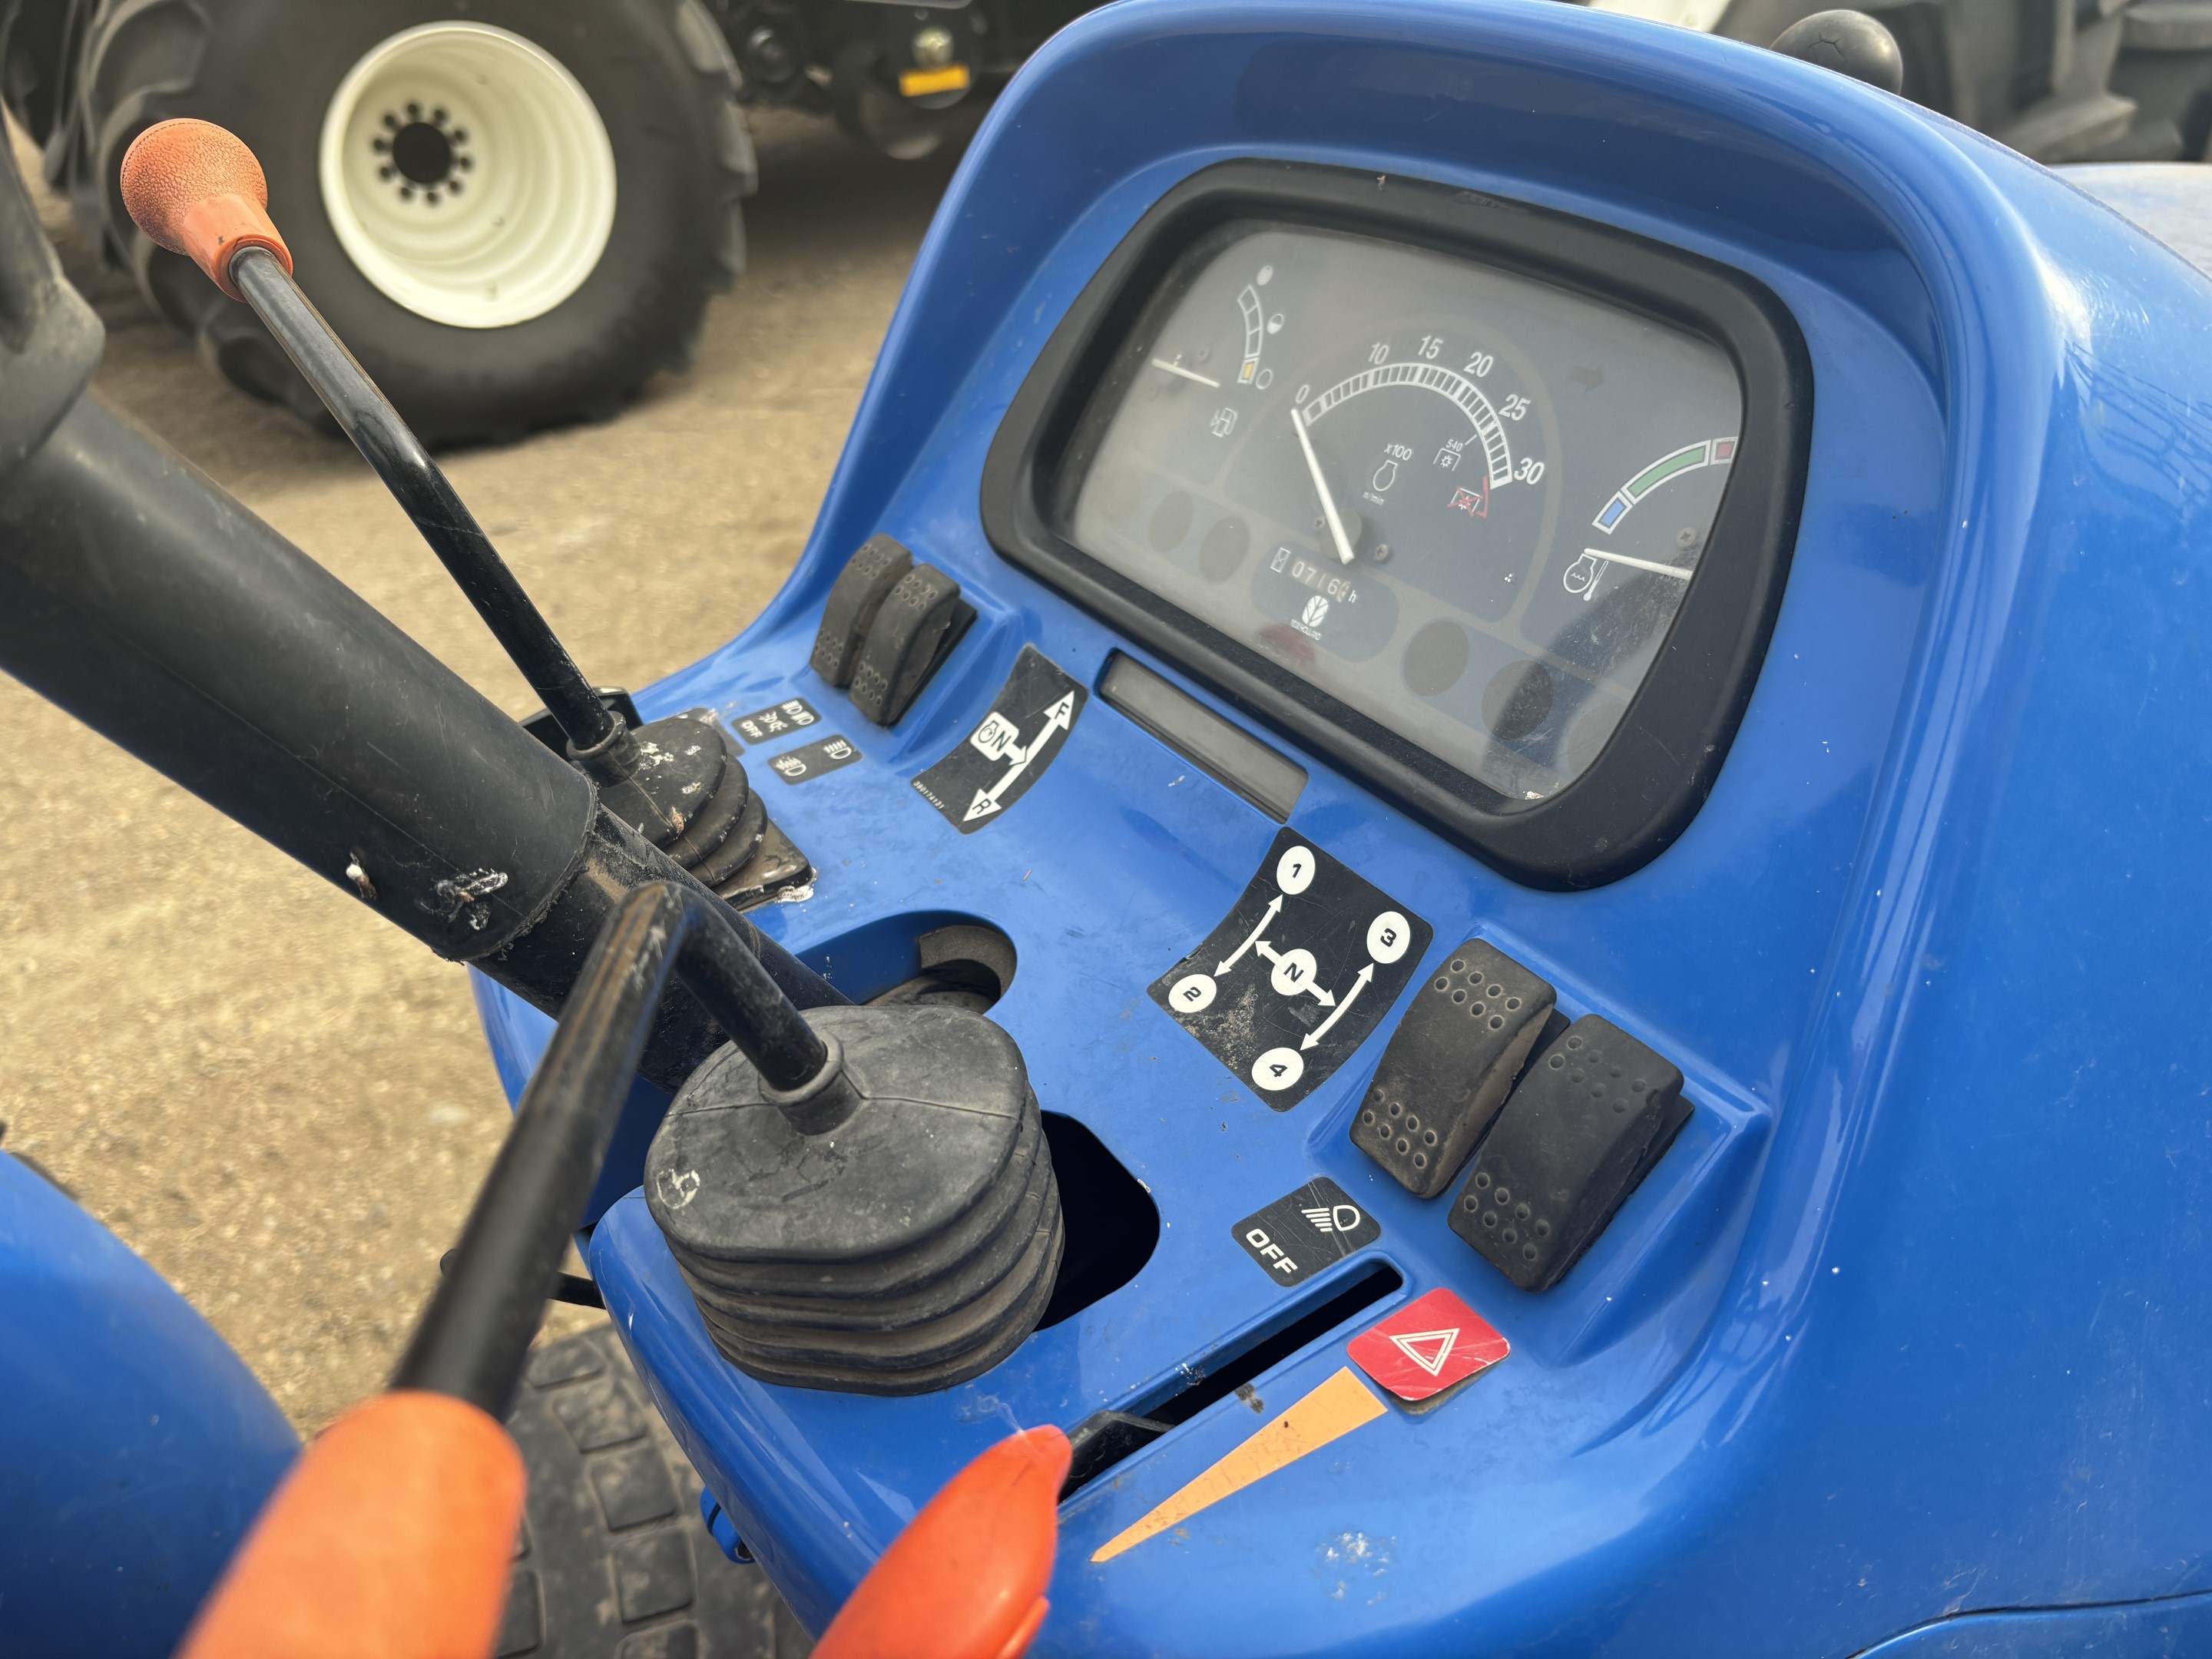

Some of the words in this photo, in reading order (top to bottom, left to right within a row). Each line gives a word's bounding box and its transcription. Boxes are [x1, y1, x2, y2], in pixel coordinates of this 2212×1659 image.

[1369, 343, 1389, 364] 10
[1418, 336, 1443, 359] 15
[1463, 352, 1492, 377] 20
[1296, 385, 1310, 404] 0
[1498, 394, 1531, 421] 25
[1383, 443, 1412, 461] x100
[1445, 439, 1463, 452] 540
[1514, 458, 1544, 485] 30
[1055, 701, 1069, 720] F
[740, 720, 763, 737] OFF
[991, 731, 1012, 752] N
[972, 798, 992, 814] R
[1292, 863, 1302, 878] 1
[1380, 928, 1397, 947] 3
[1283, 962, 1304, 982] N
[1183, 986, 1202, 1002] 2
[1269, 1063, 1288, 1077] 4
[1246, 1228, 1298, 1274] OFF
